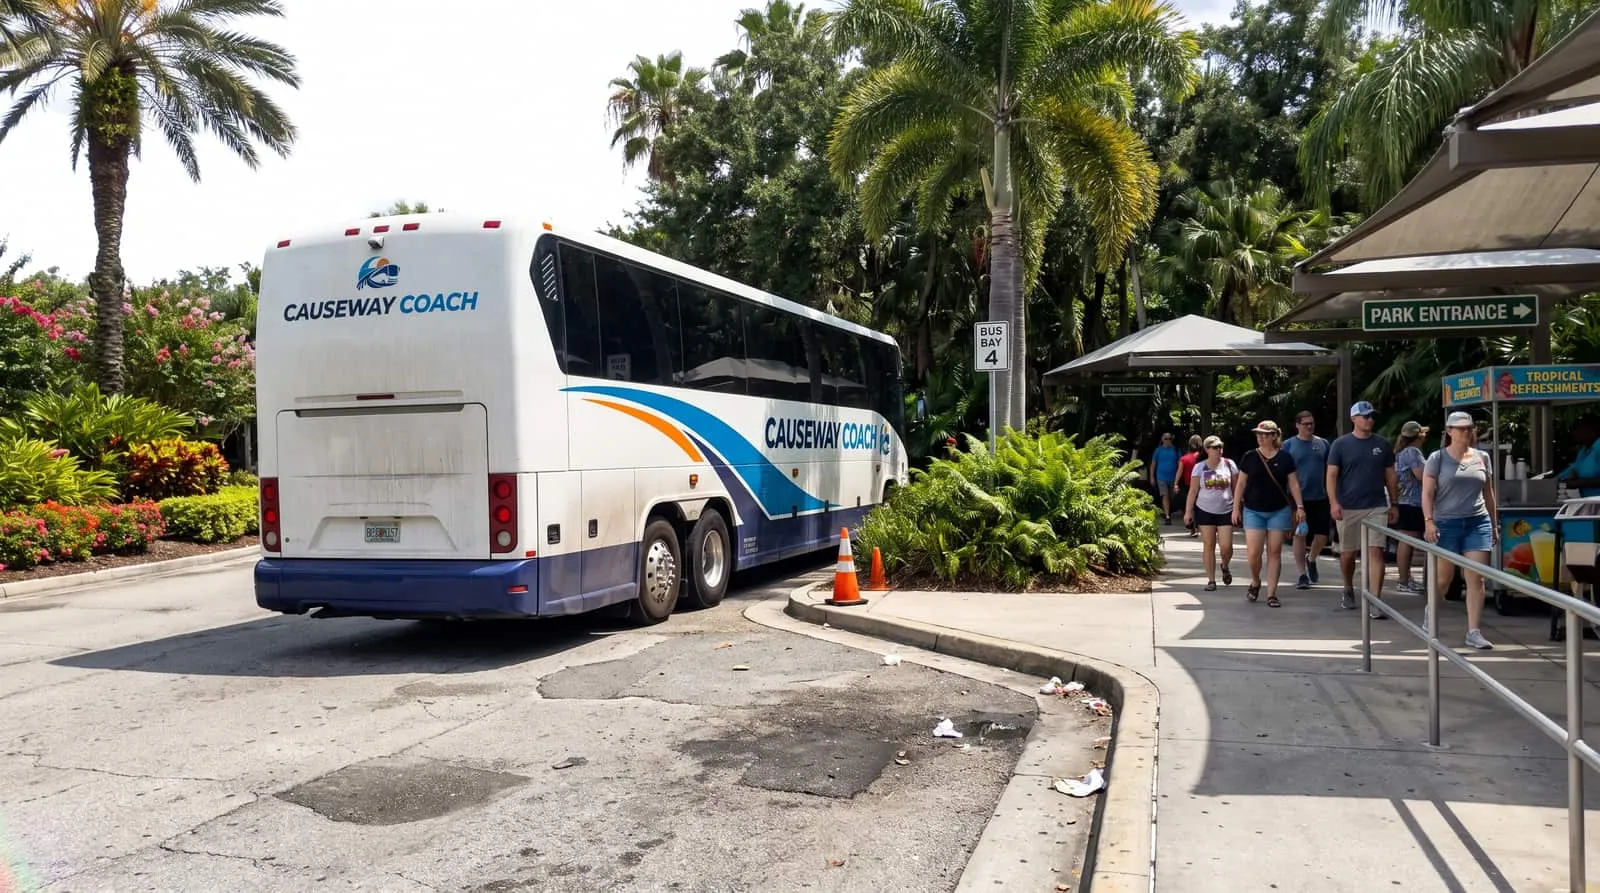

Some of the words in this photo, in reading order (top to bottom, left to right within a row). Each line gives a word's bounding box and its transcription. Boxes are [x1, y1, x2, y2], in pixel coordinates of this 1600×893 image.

[284, 296, 397, 321] CAUSEWAY
[400, 291, 479, 314] COACH
[1371, 307, 1414, 323] PARK
[1419, 303, 1508, 322] ENTRANCE
[980, 326, 1003, 336] BUS
[980, 338, 1002, 347] BAY
[984, 350, 999, 365] 4
[1526, 370, 1584, 382] TROPICAL
[1510, 382, 1600, 394] REFRESHMENTS
[765, 417, 842, 449] CAUSEWAY
[842, 422, 878, 449] COACH
